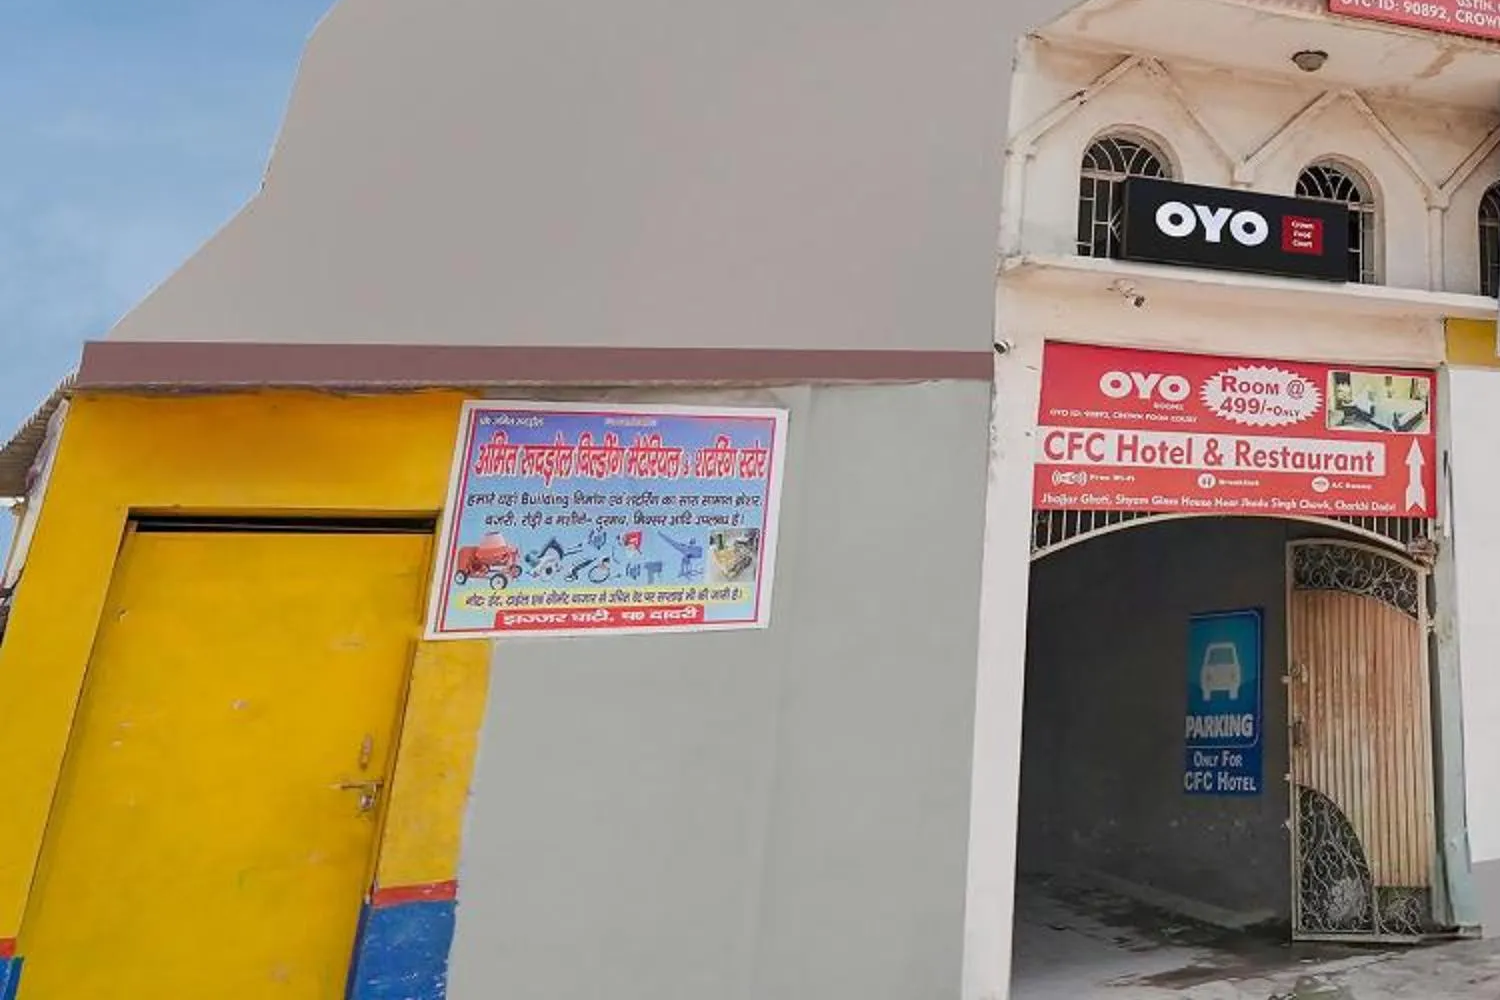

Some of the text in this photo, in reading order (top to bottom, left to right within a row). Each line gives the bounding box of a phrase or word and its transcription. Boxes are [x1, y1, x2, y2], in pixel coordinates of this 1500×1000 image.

[1155, 200, 1270, 247] OYO
[1099, 370, 1191, 402] OYO
[1285, 378, 1305, 400] @
[1043, 430, 1376, 473] CFC Hotel & Restaurant
[521, 491, 569, 508] Building
[1185, 713, 1254, 739] PARKING
[1183, 771, 1213, 792] CFC
